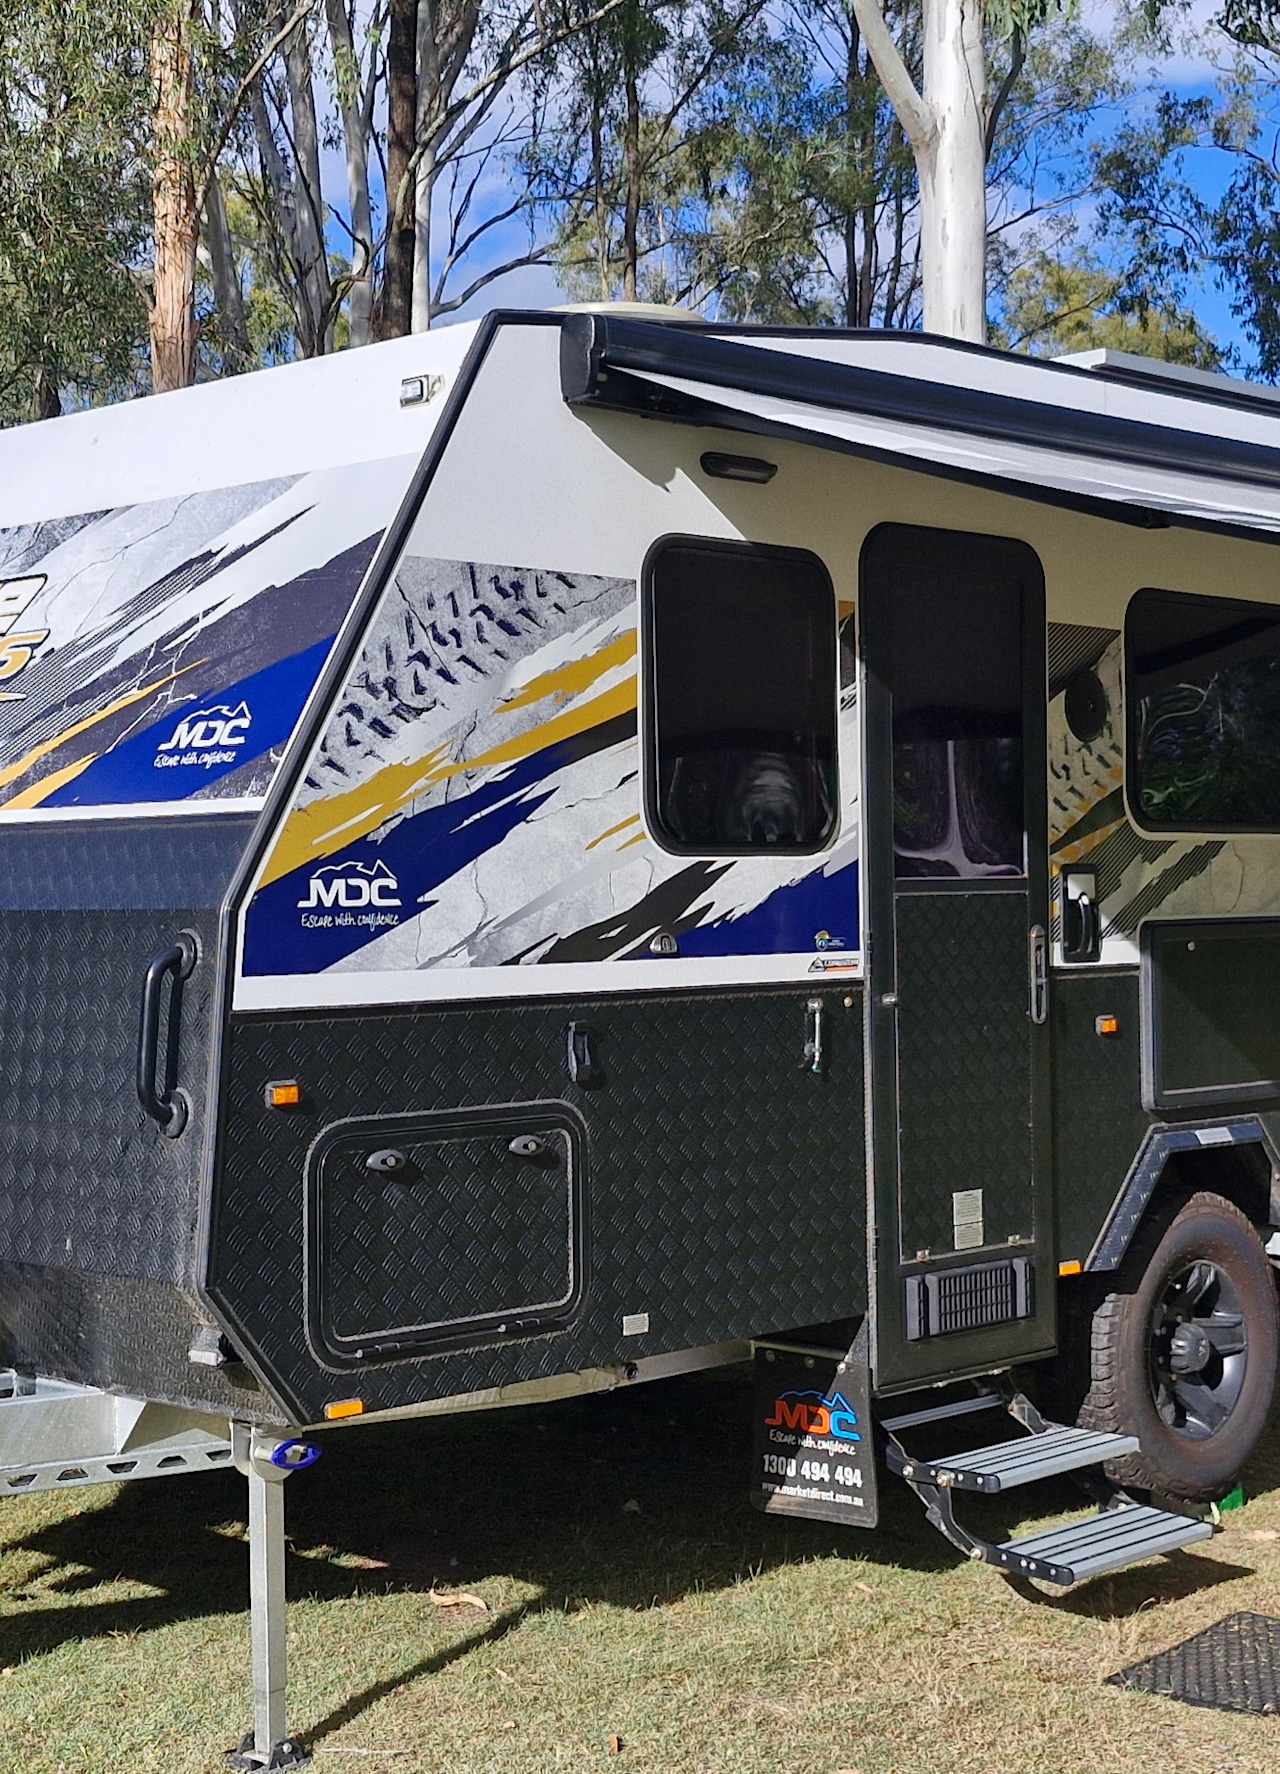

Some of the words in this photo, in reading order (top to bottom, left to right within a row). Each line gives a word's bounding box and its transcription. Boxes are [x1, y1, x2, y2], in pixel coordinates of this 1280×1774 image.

[157, 718, 251, 751] MDC
[297, 878, 402, 908] MDC
[301, 913, 333, 928] Escape
[335, 912, 356, 926] with
[357, 912, 400, 932] confidence
[764, 1400, 861, 1442] MDC
[763, 1454, 797, 1477] 1300
[801, 1460, 830, 1483] 494
[835, 1465, 863, 1488] 494
